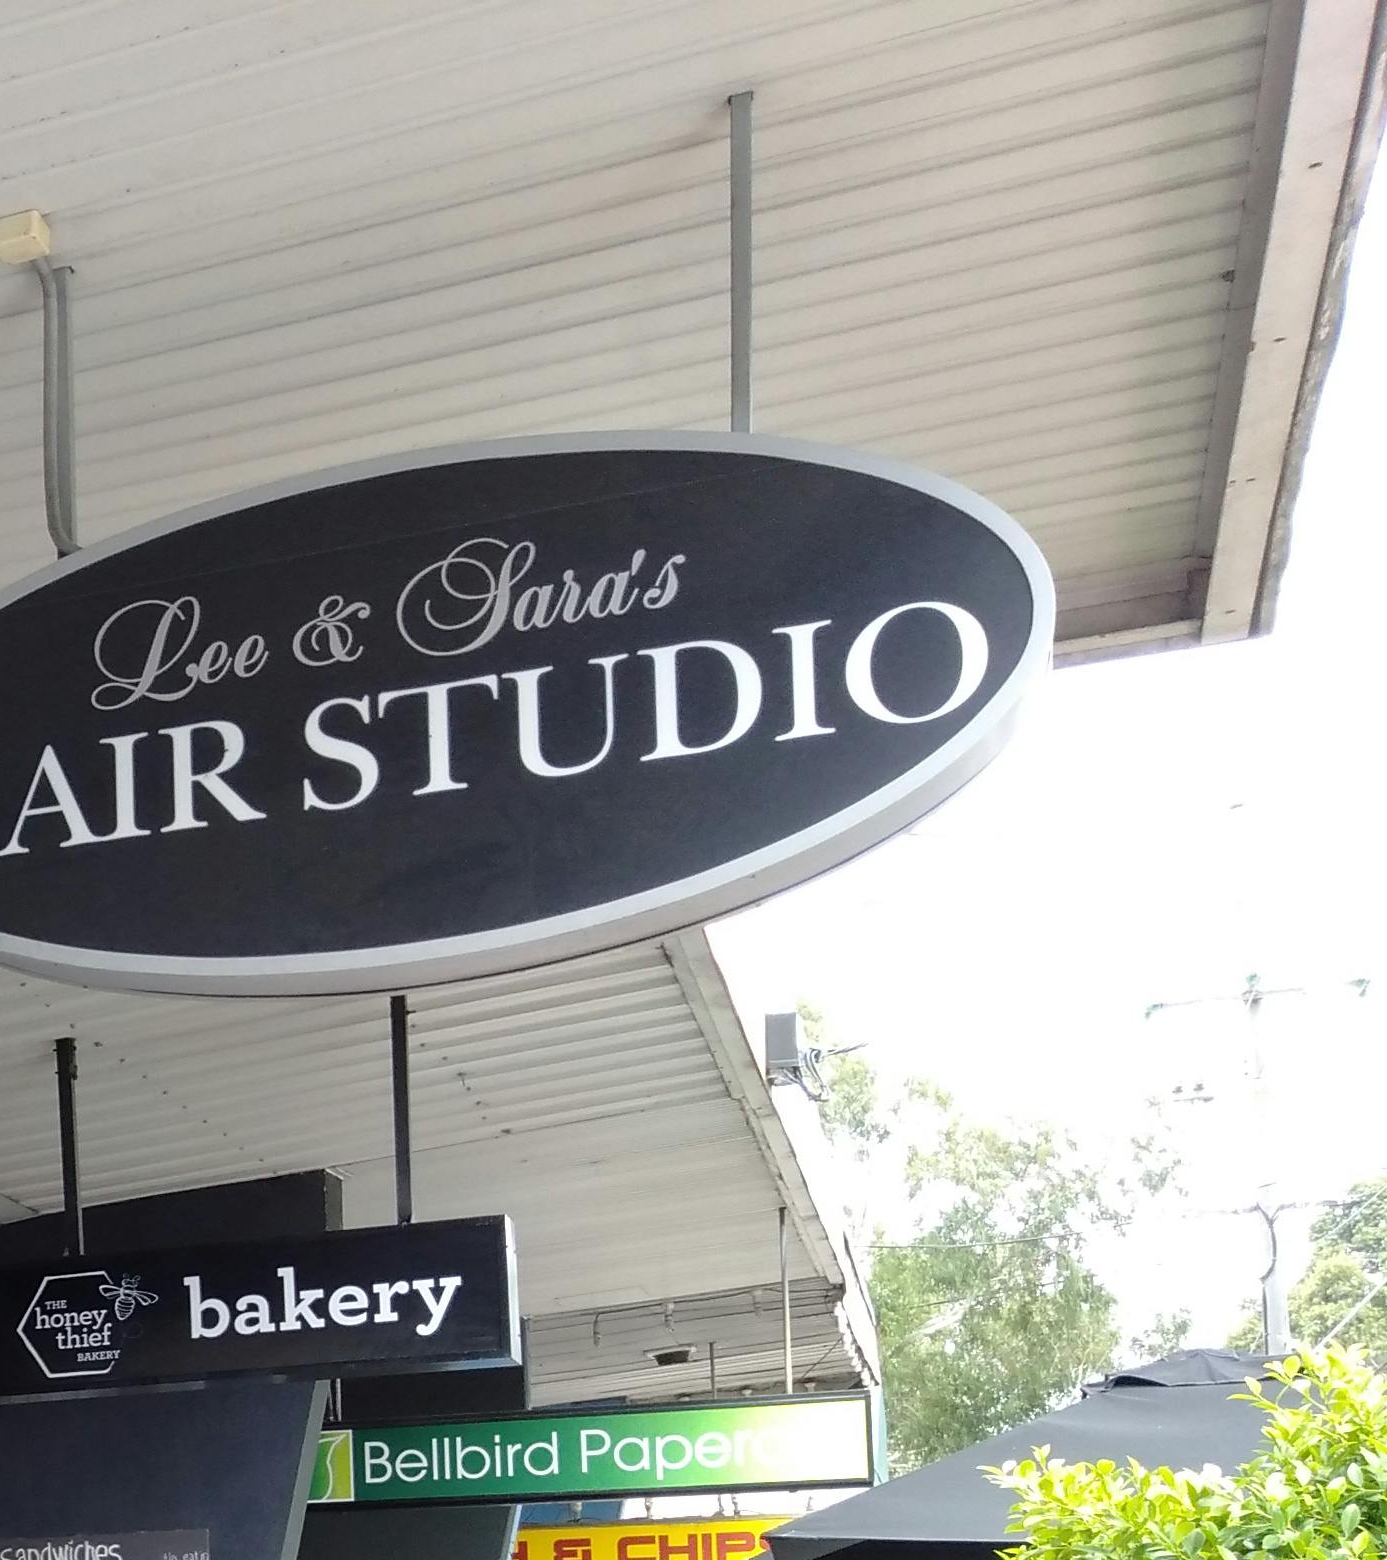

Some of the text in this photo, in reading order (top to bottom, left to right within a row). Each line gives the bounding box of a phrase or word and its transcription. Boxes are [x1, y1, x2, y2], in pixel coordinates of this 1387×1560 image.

[89, 537, 688, 712] Lee & Sara's
[301, 600, 991, 812] STUDIO
[34, 1306, 108, 1330] honey
[44, 1299, 68, 1310] THE
[183, 1267, 462, 1341] bakery
[55, 1323, 113, 1350] thief
[77, 1350, 121, 1362] BAKERY
[364, 1431, 559, 1484] Bellbird
